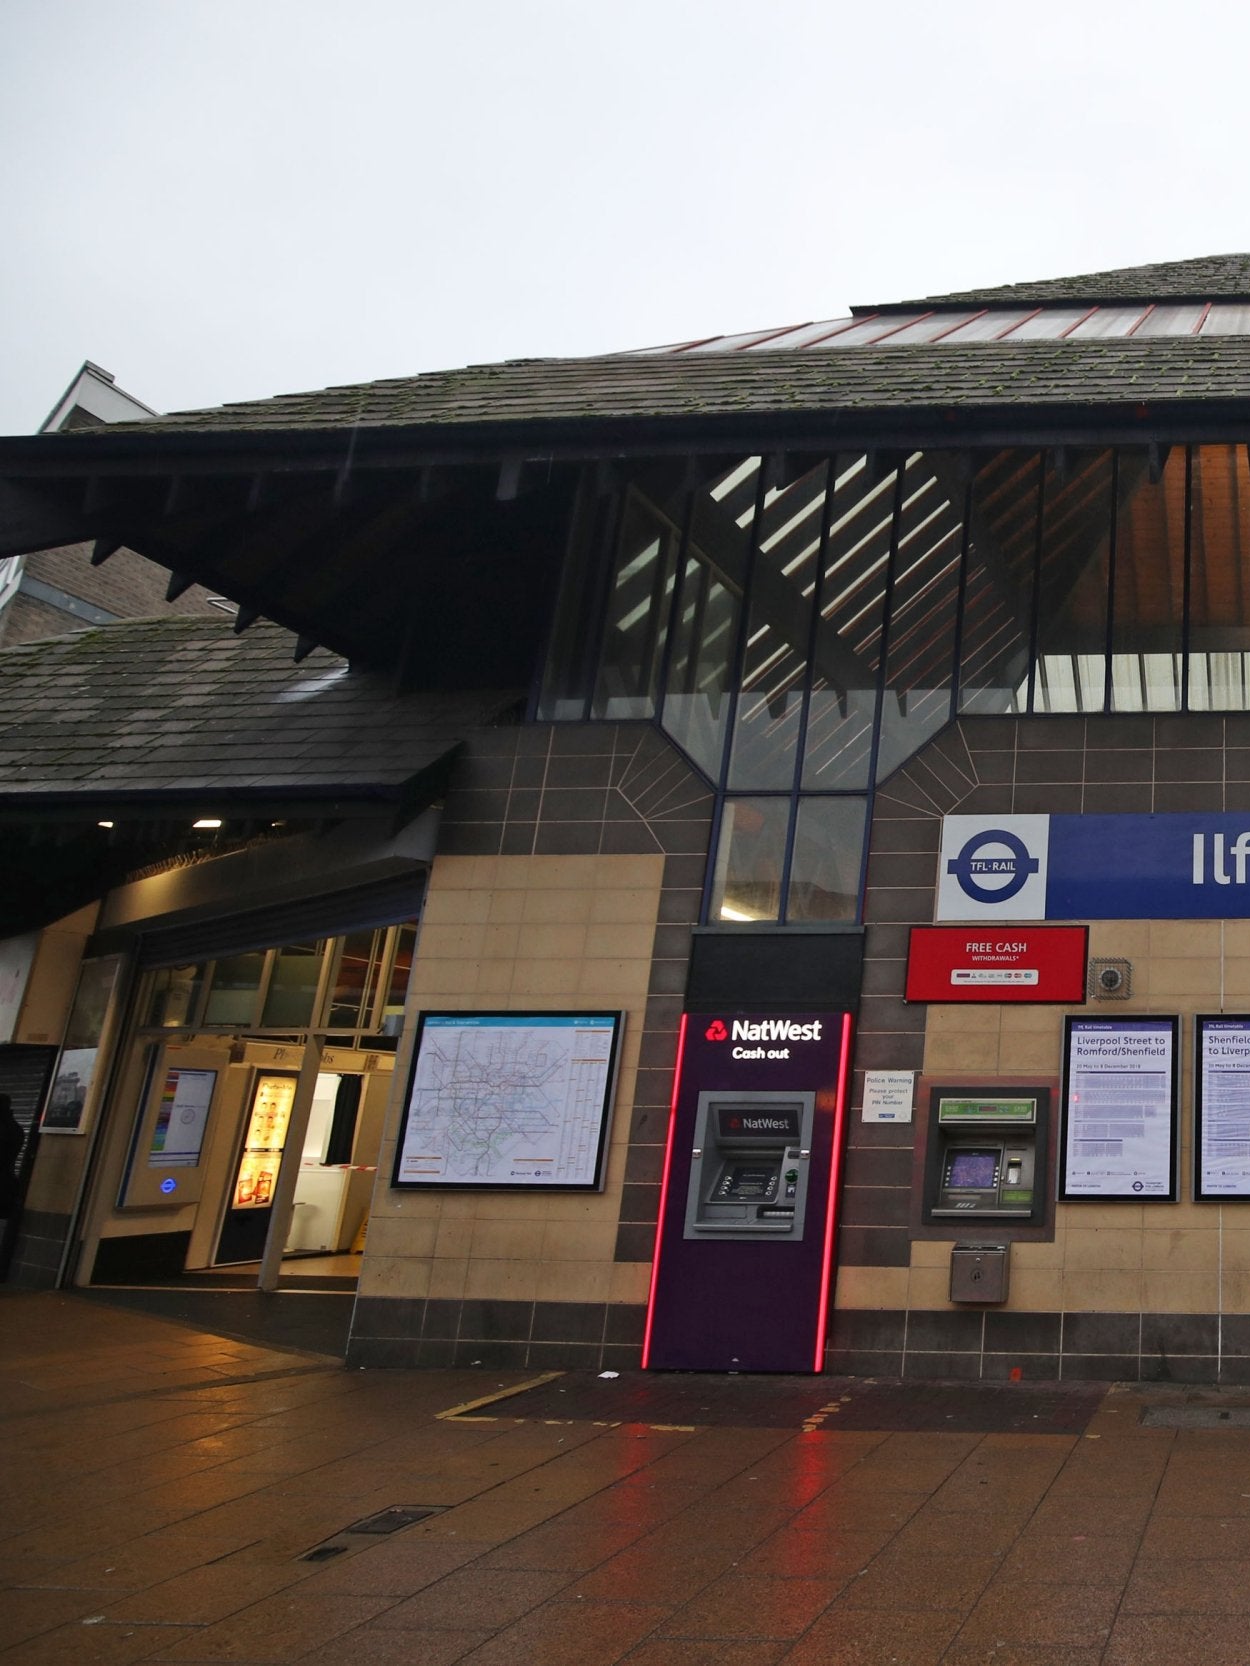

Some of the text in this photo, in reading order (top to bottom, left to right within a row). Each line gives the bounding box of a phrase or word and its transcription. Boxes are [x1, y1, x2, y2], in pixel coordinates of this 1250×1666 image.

[966, 943, 1027, 952] FREE CASH
[731, 1020, 822, 1040] NatWest
[1077, 1037, 1120, 1046] Liverpool
[1124, 1037, 1152, 1045] Street
[732, 1047, 790, 1059] Cash out
[1077, 1047, 1165, 1056] Romford/Shenfield
[743, 1119, 790, 1129] NatWest
